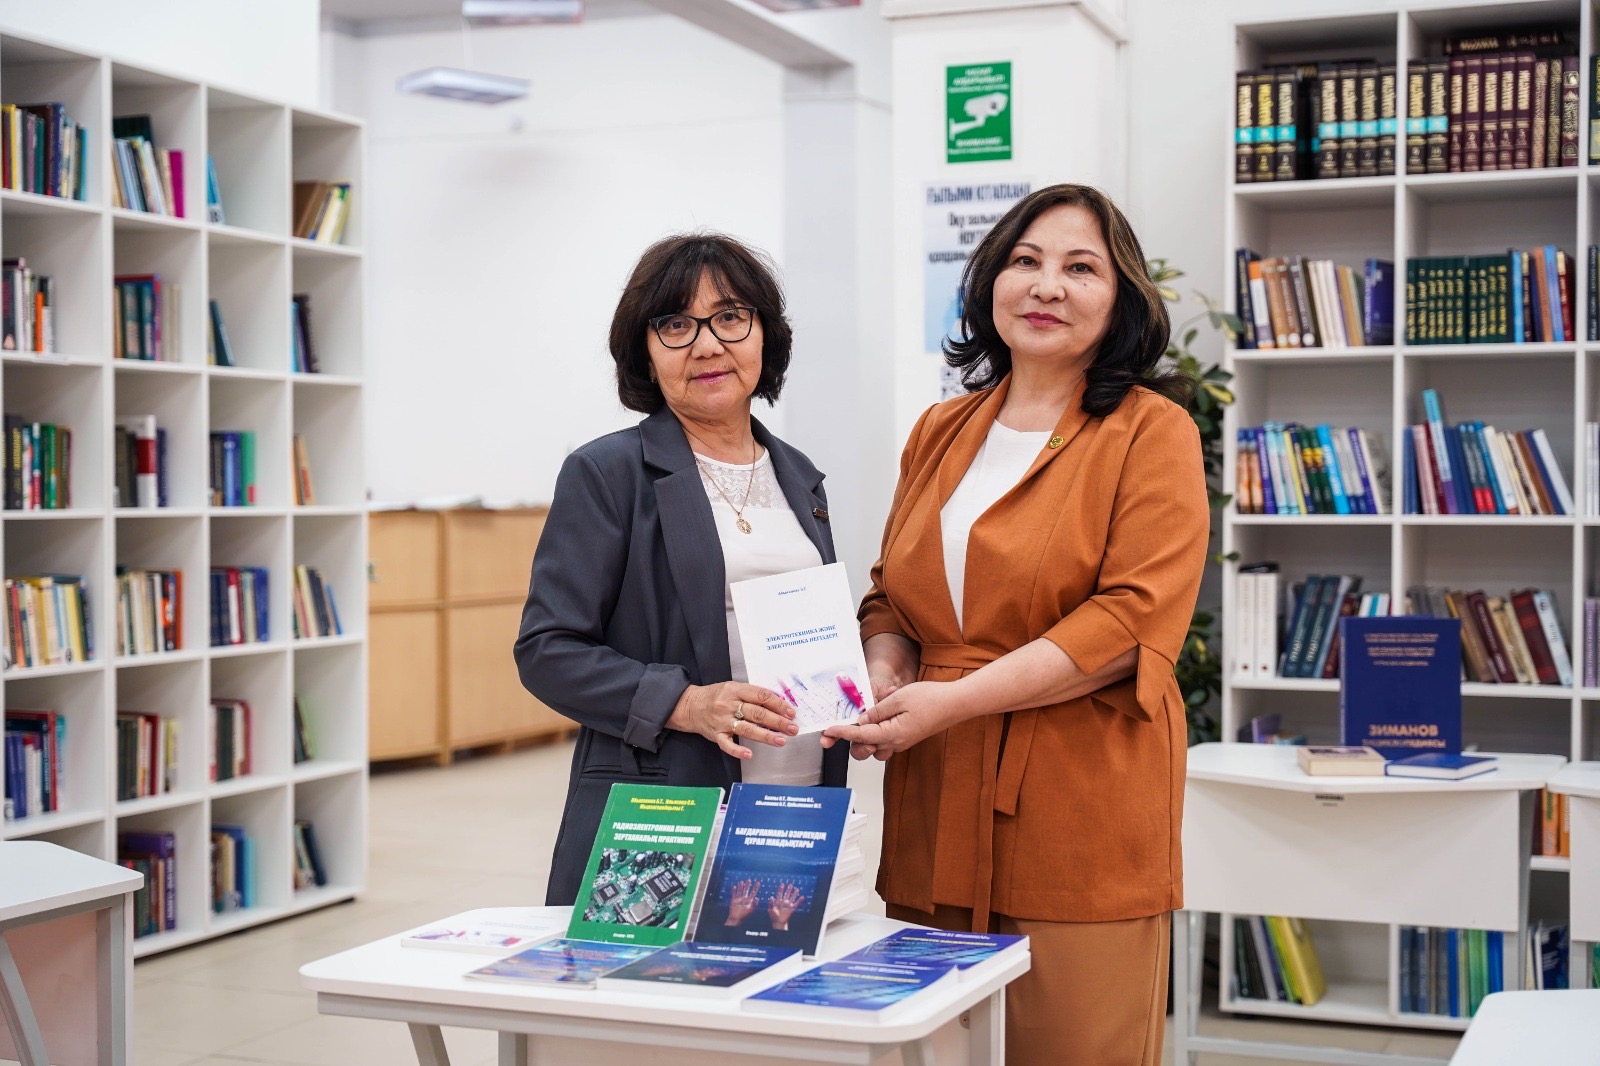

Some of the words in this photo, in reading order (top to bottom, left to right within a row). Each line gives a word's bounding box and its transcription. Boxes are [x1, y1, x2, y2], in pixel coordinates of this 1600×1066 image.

[766, 628, 818, 642] ЭЛЕКТРОТЕХНИКА
[767, 638, 809, 650] ЭЛЕКТРОНИКА
[1368, 724, 1438, 736] ЗИМАНОВ
[612, 822, 675, 833] РАДИОЭЛЕКТРОНИКА
[658, 836, 695, 845] ПРАКТИКУМ
